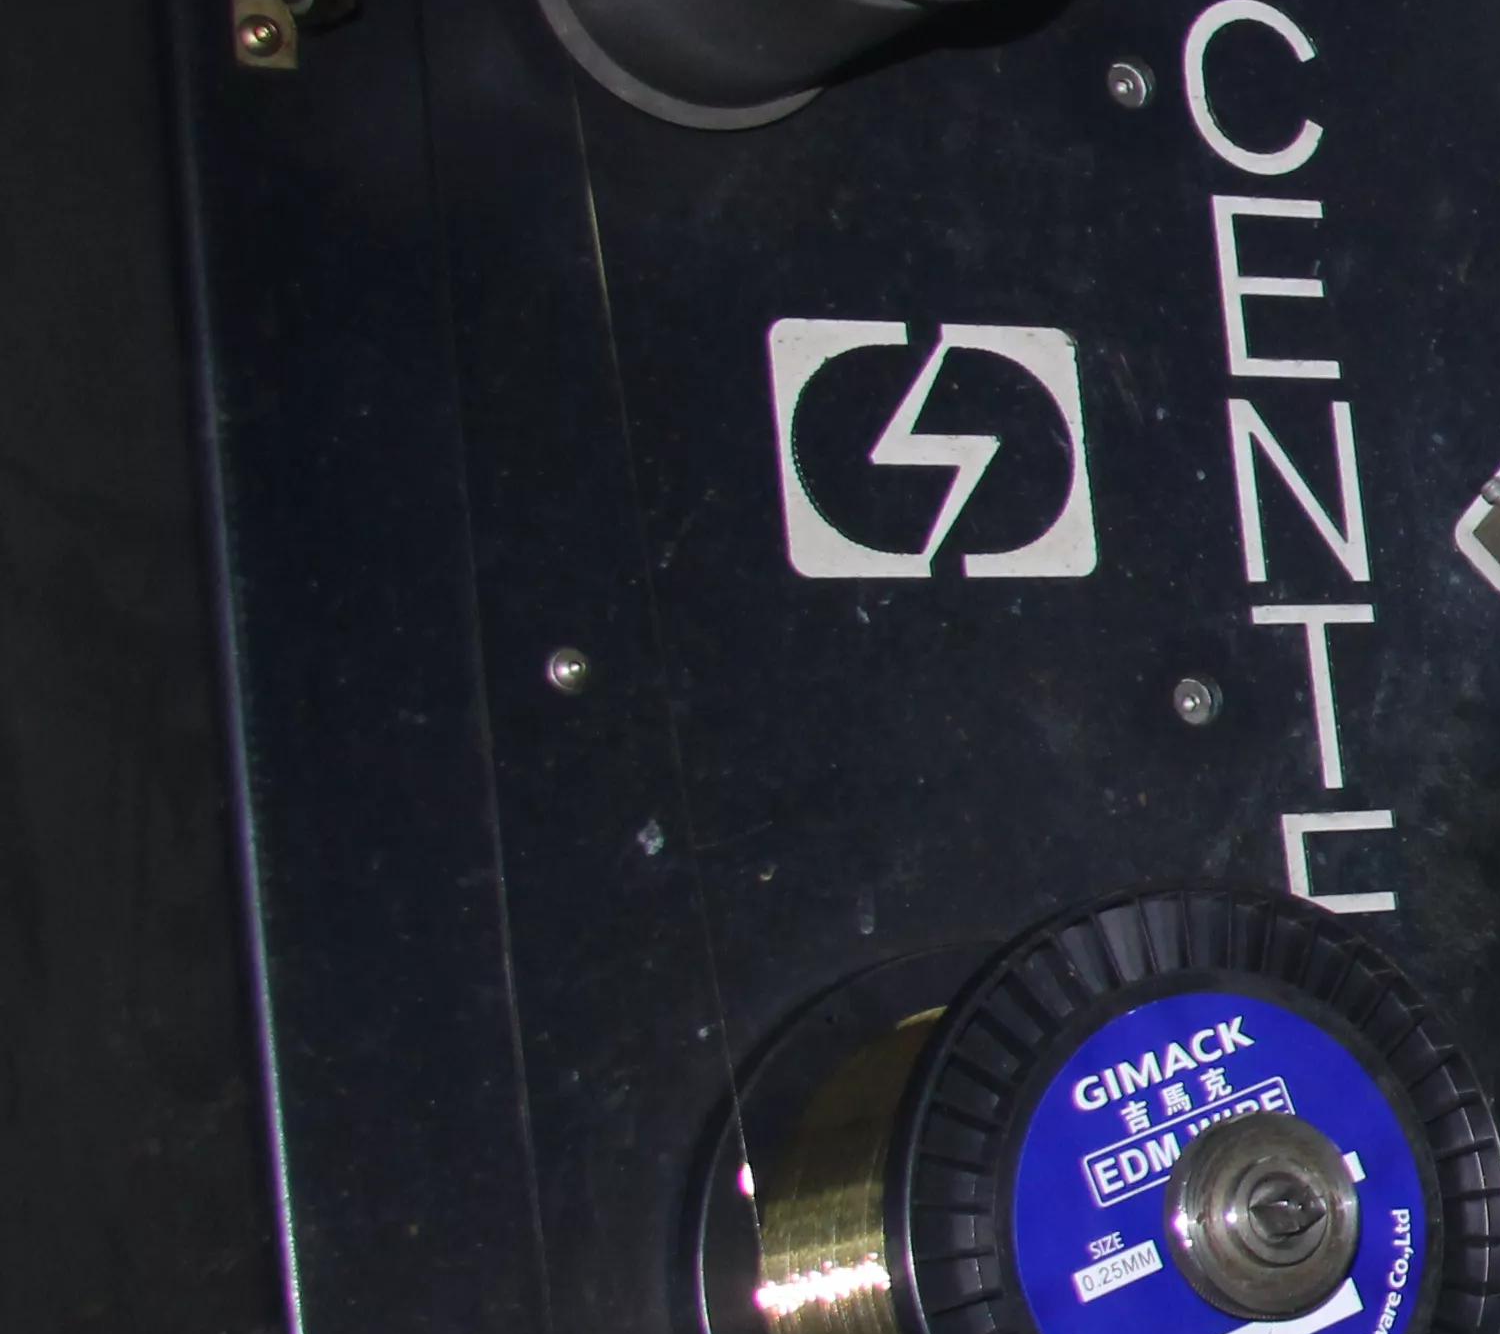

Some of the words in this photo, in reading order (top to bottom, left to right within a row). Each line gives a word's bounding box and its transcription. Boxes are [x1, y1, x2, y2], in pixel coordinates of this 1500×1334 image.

[1073, 1016, 1255, 1111] GIMACK
[1093, 1132, 1182, 1195] EDM
[1081, 1247, 1156, 1292] 0.25MM
[1088, 1231, 1126, 1260] SIZE
